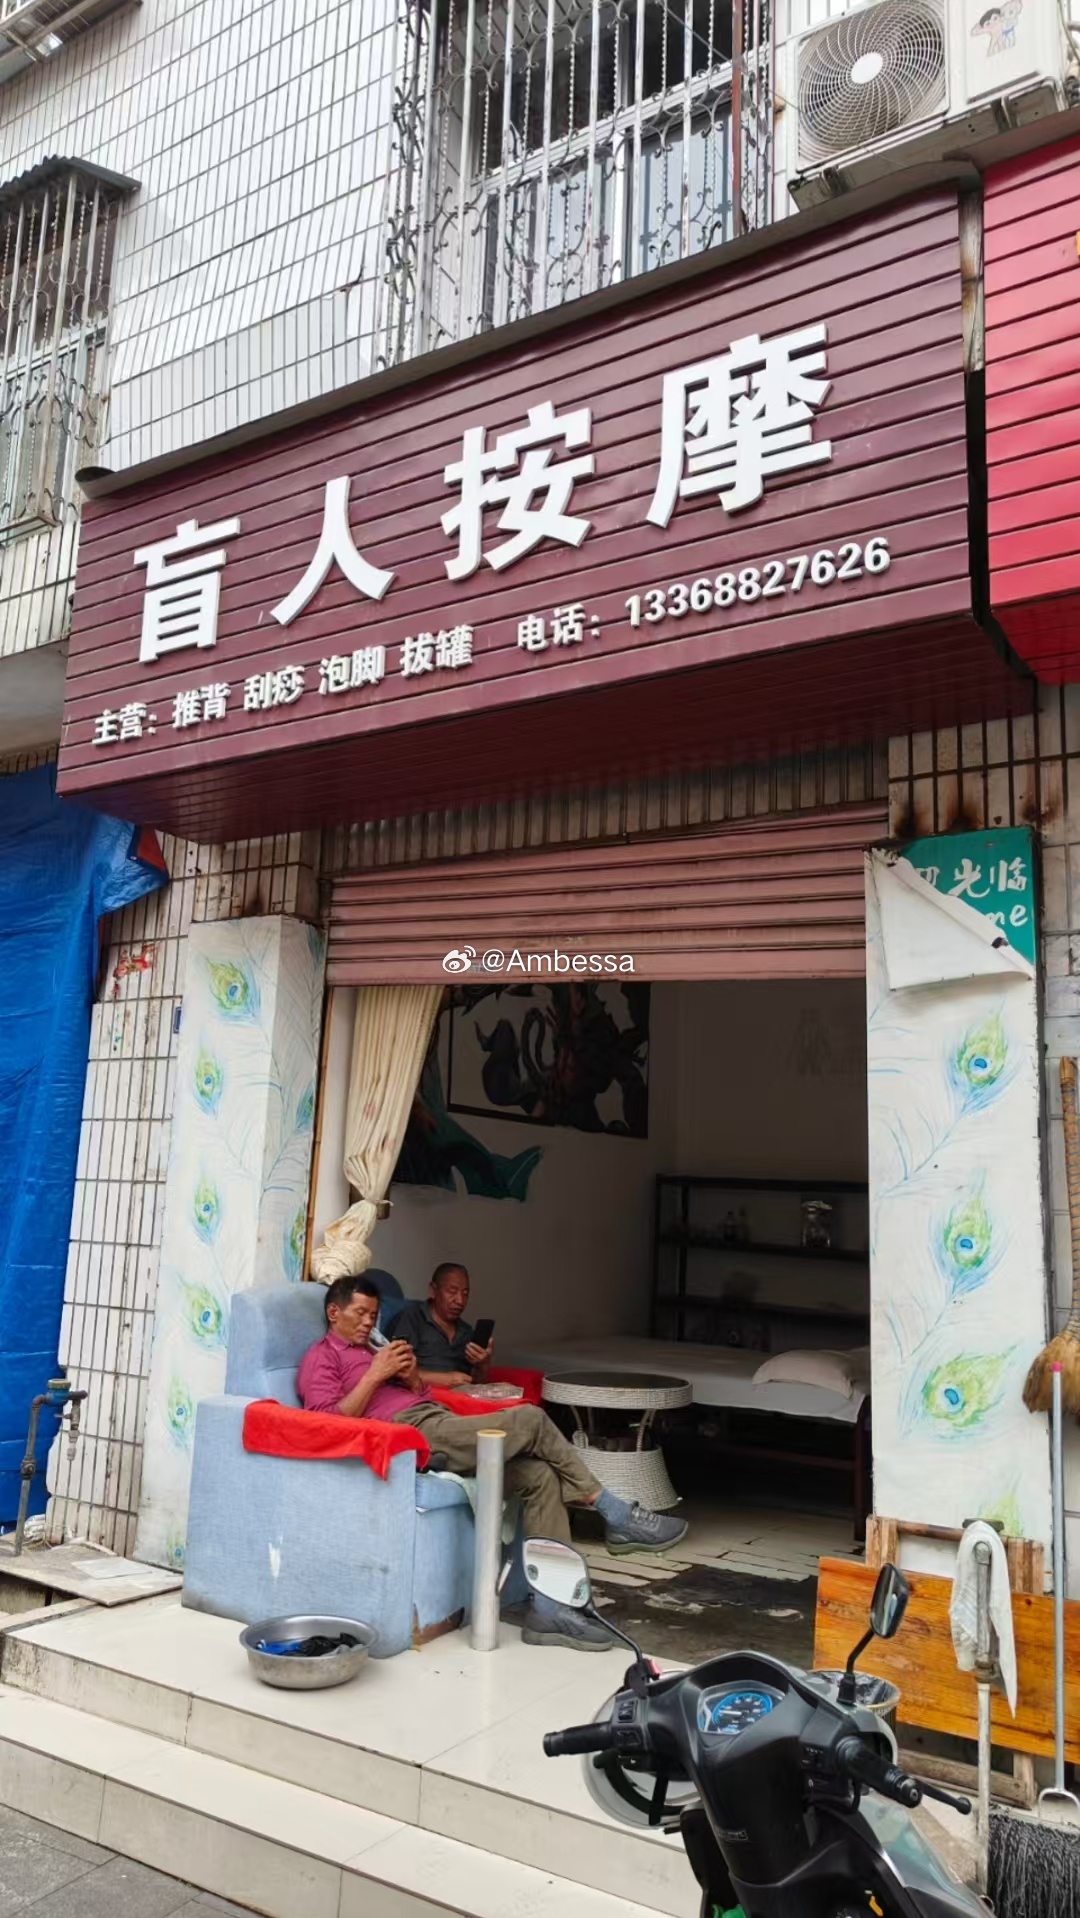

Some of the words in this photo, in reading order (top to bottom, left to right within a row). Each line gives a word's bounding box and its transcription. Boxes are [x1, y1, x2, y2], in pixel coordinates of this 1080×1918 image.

[133, 323, 833, 663] 盲人按摩
[517, 603, 599, 651] 电话：
[625, 537, 890, 627] 13368827626
[92, 702, 157, 746] 主营：
[171, 682, 231, 728] 推背
[243, 665, 305, 712] 刮痧
[318, 645, 386, 695] 泡脚
[400, 625, 474, 676] 拔罐
